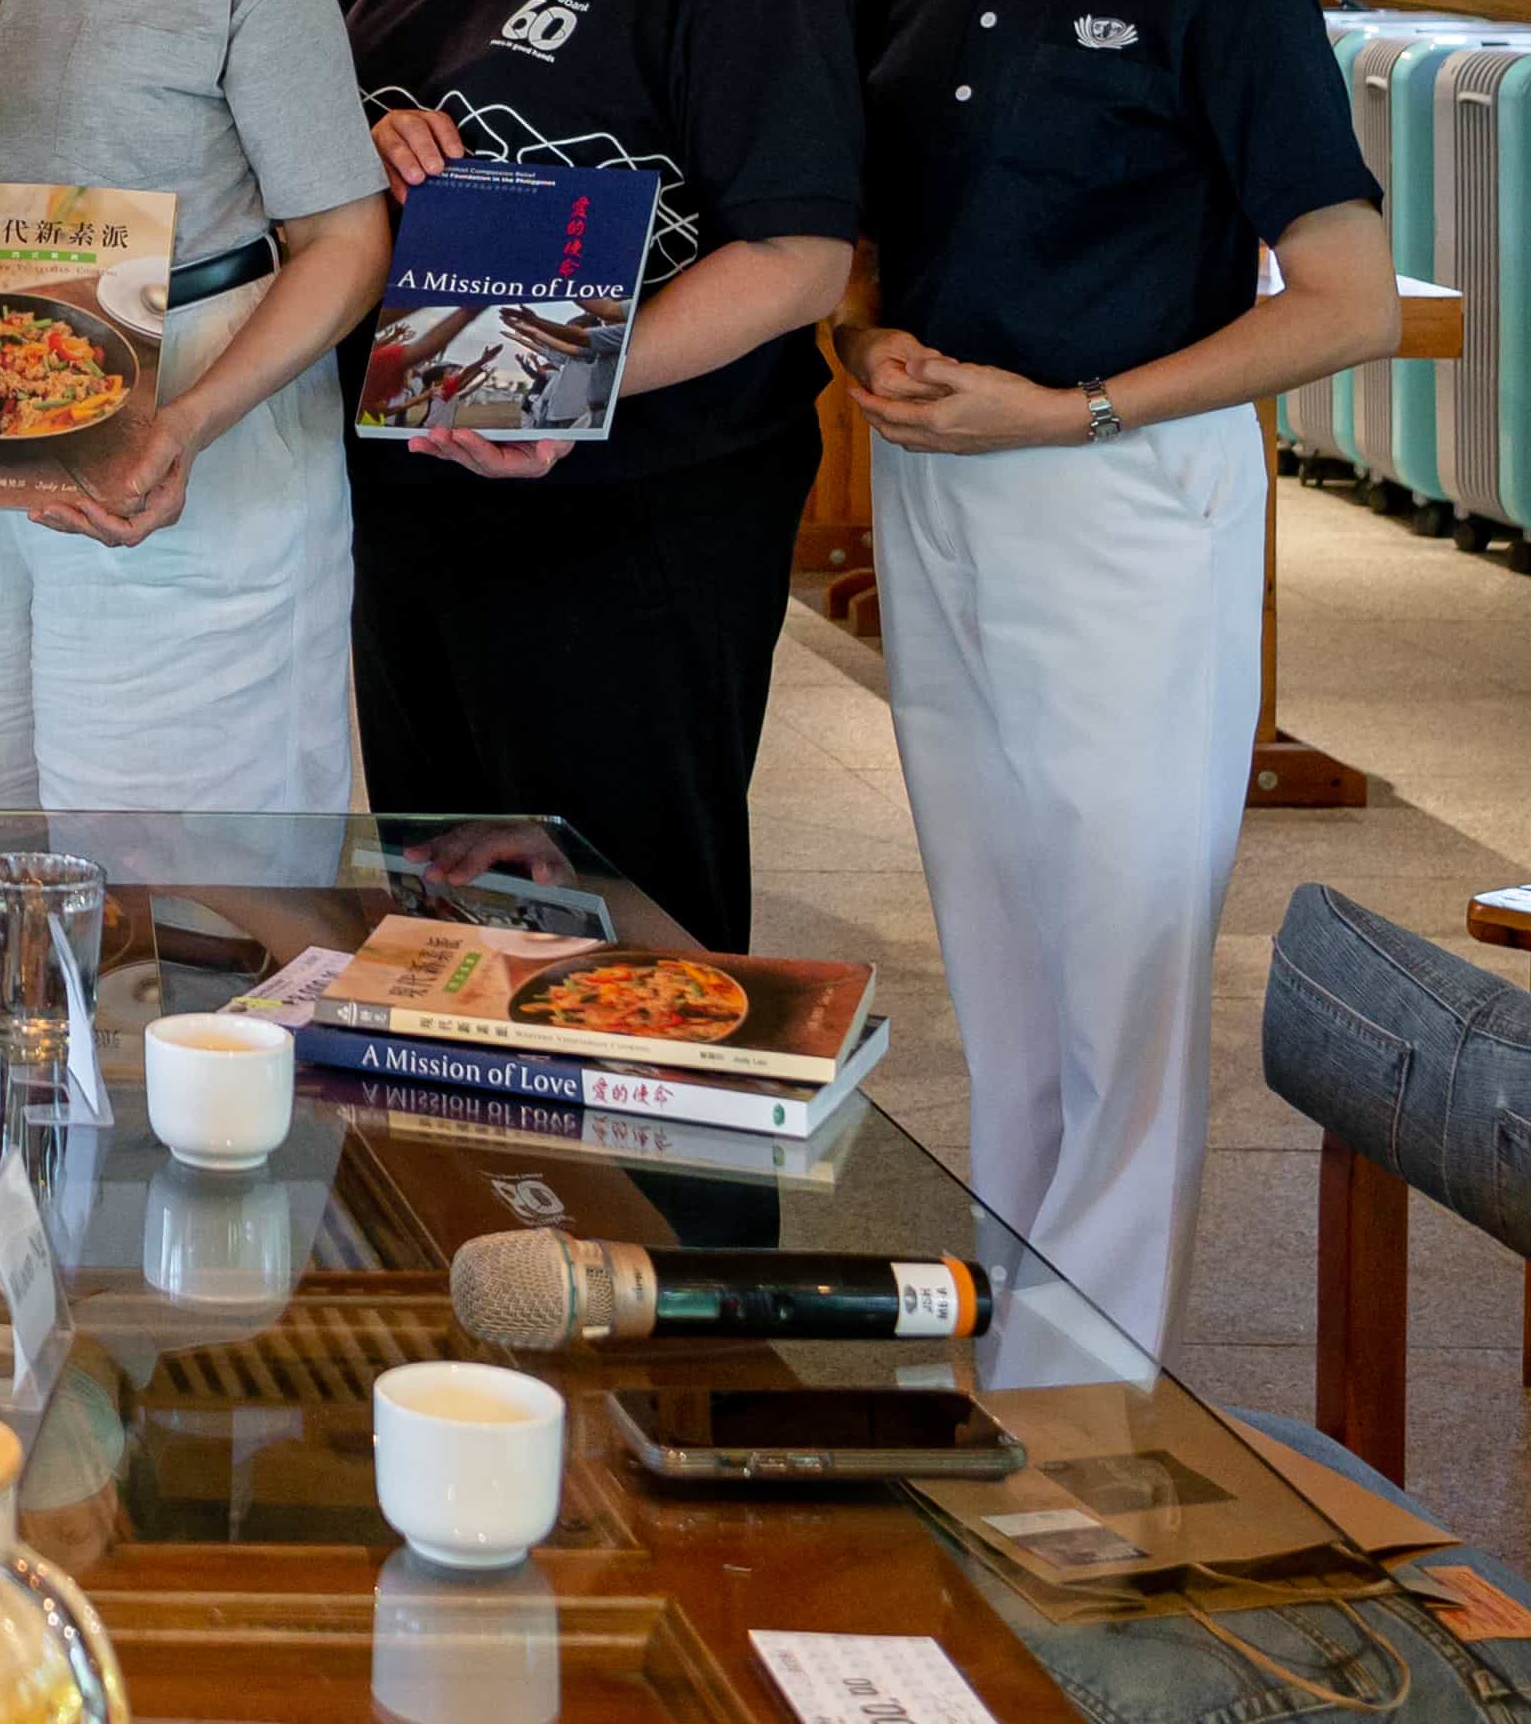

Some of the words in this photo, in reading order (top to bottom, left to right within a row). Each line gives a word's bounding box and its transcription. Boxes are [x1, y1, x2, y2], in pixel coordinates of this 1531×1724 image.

[396, 269, 417, 288] A
[423, 272, 524, 297] Mission
[531, 277, 562, 298] of
[564, 279, 625, 299] Love
[361, 1044, 380, 1068] A
[386, 1046, 480, 1084] Mission
[488, 1062, 516, 1088] of
[520, 1066, 578, 1097] Love
